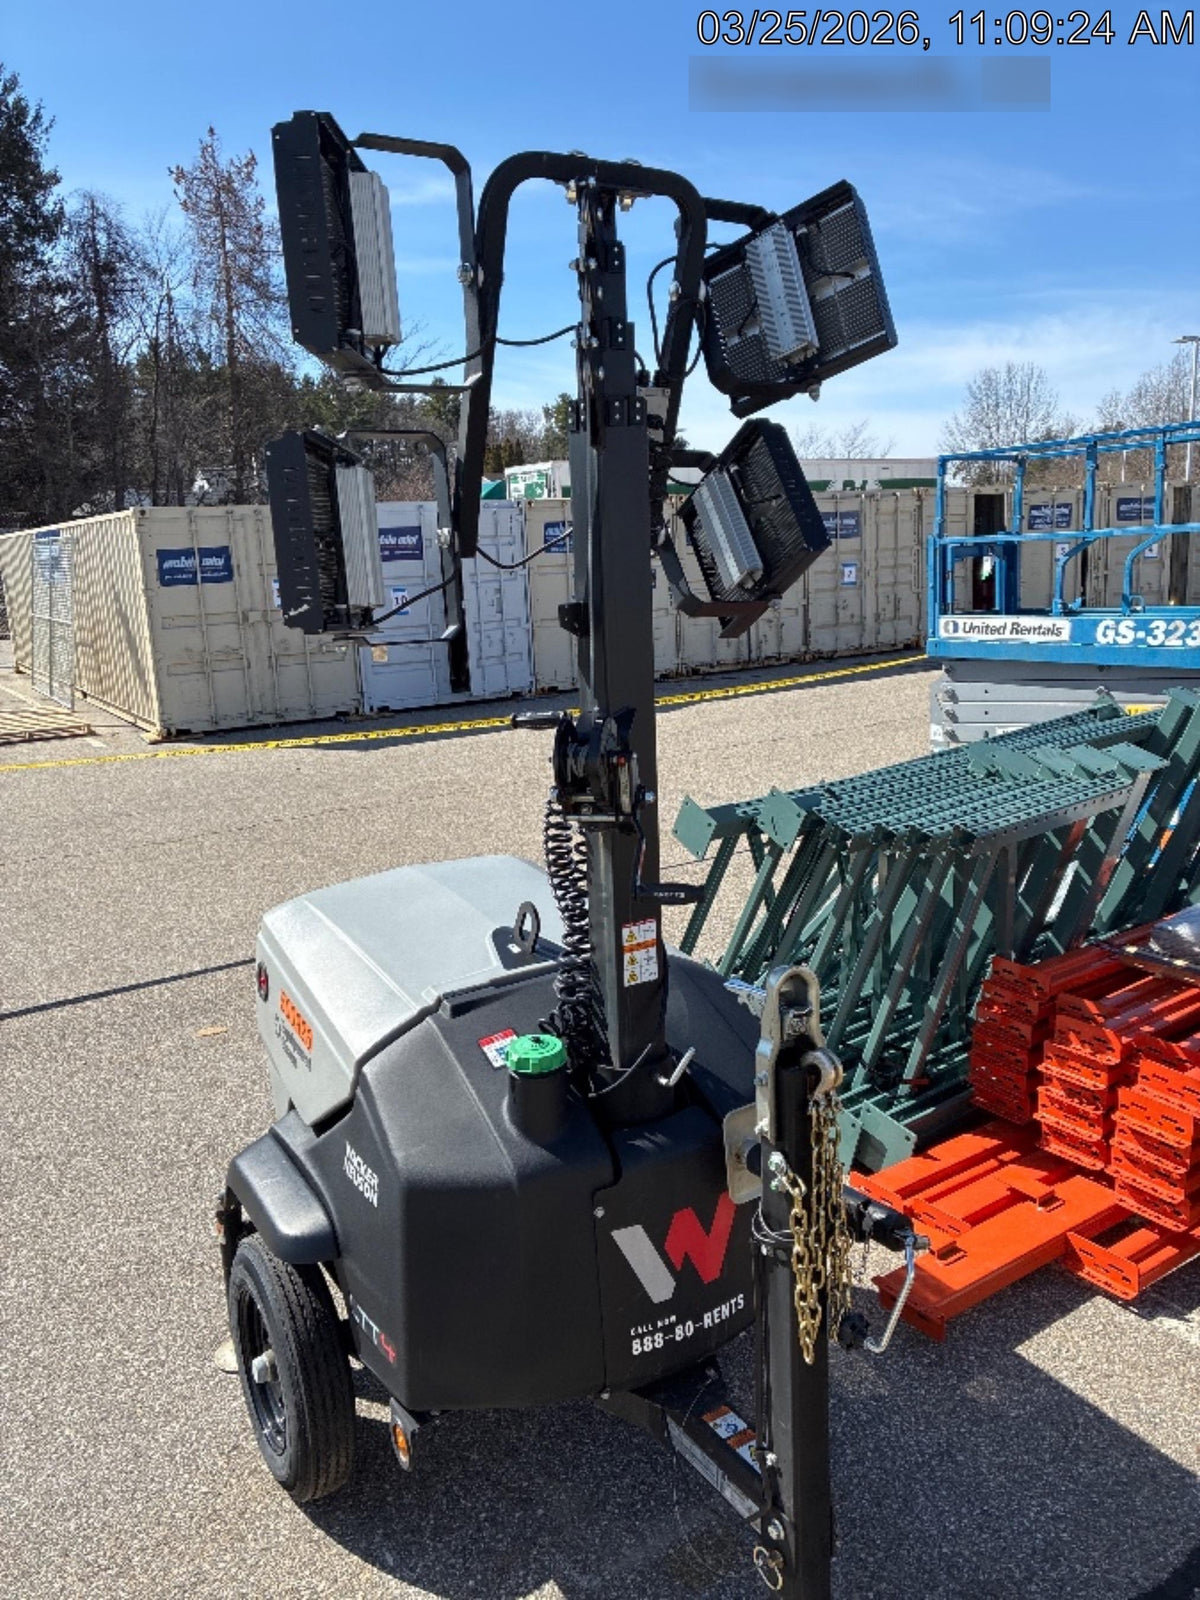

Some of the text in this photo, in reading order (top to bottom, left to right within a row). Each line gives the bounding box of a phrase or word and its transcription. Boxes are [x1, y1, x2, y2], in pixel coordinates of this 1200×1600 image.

[394, 596, 408, 606] 10
[962, 620, 1064, 637] United Rentals
[630, 1324, 653, 1336] CALL
[632, 1293, 745, 1355] 888-80-RENTS
